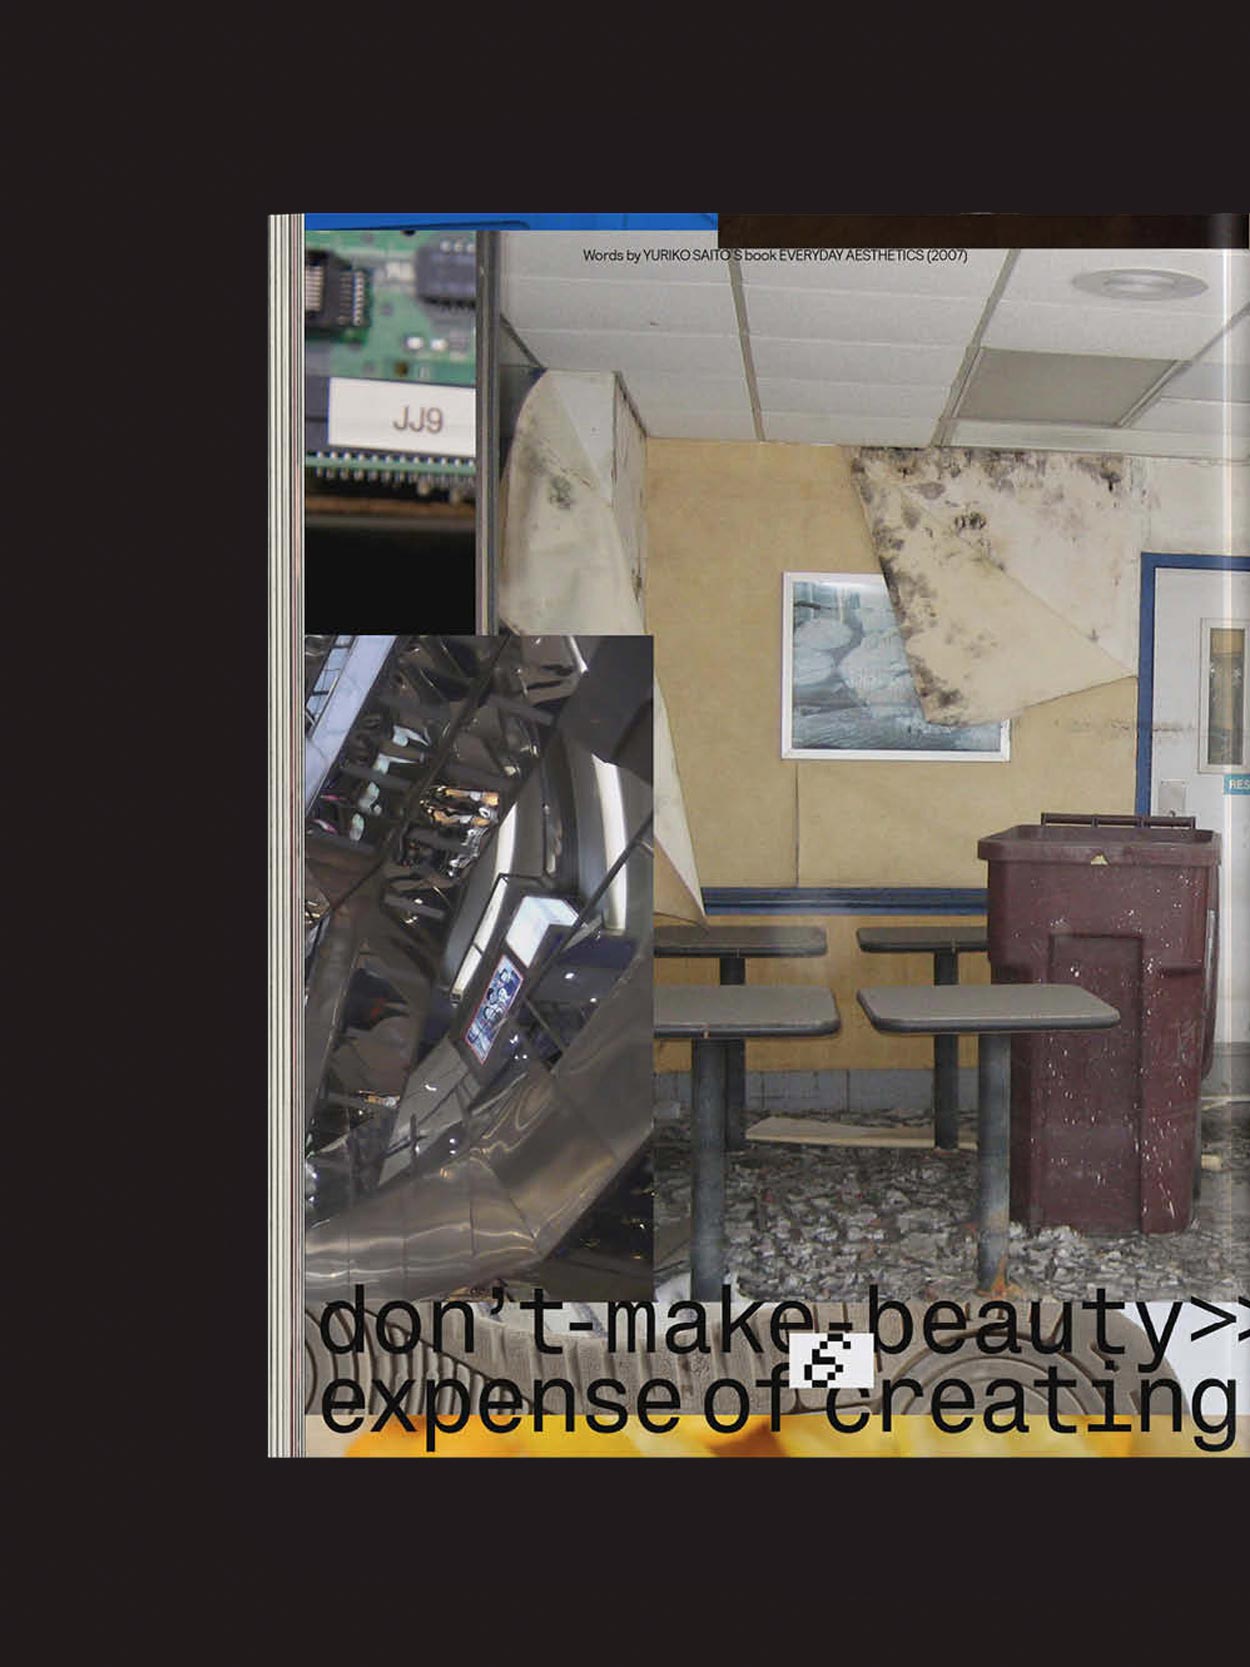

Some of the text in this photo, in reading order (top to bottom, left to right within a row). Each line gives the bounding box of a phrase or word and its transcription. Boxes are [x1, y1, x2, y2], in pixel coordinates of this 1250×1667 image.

[583, 249, 624, 261] Words
[627, 249, 640, 264] by
[643, 249, 690, 261] YURIKO
[745, 249, 777, 261] book
[779, 249, 844, 261] EVERYDAY
[845, 249, 924, 261] AESTHETICS
[926, 249, 967, 263] (2007)
[392, 405, 443, 434] JJ9
[804, 1333, 851, 1388] 6
[322, 1377, 680, 1452] expense
[704, 1362, 789, 1434] of
[826, 1362, 1236, 1453] creating
